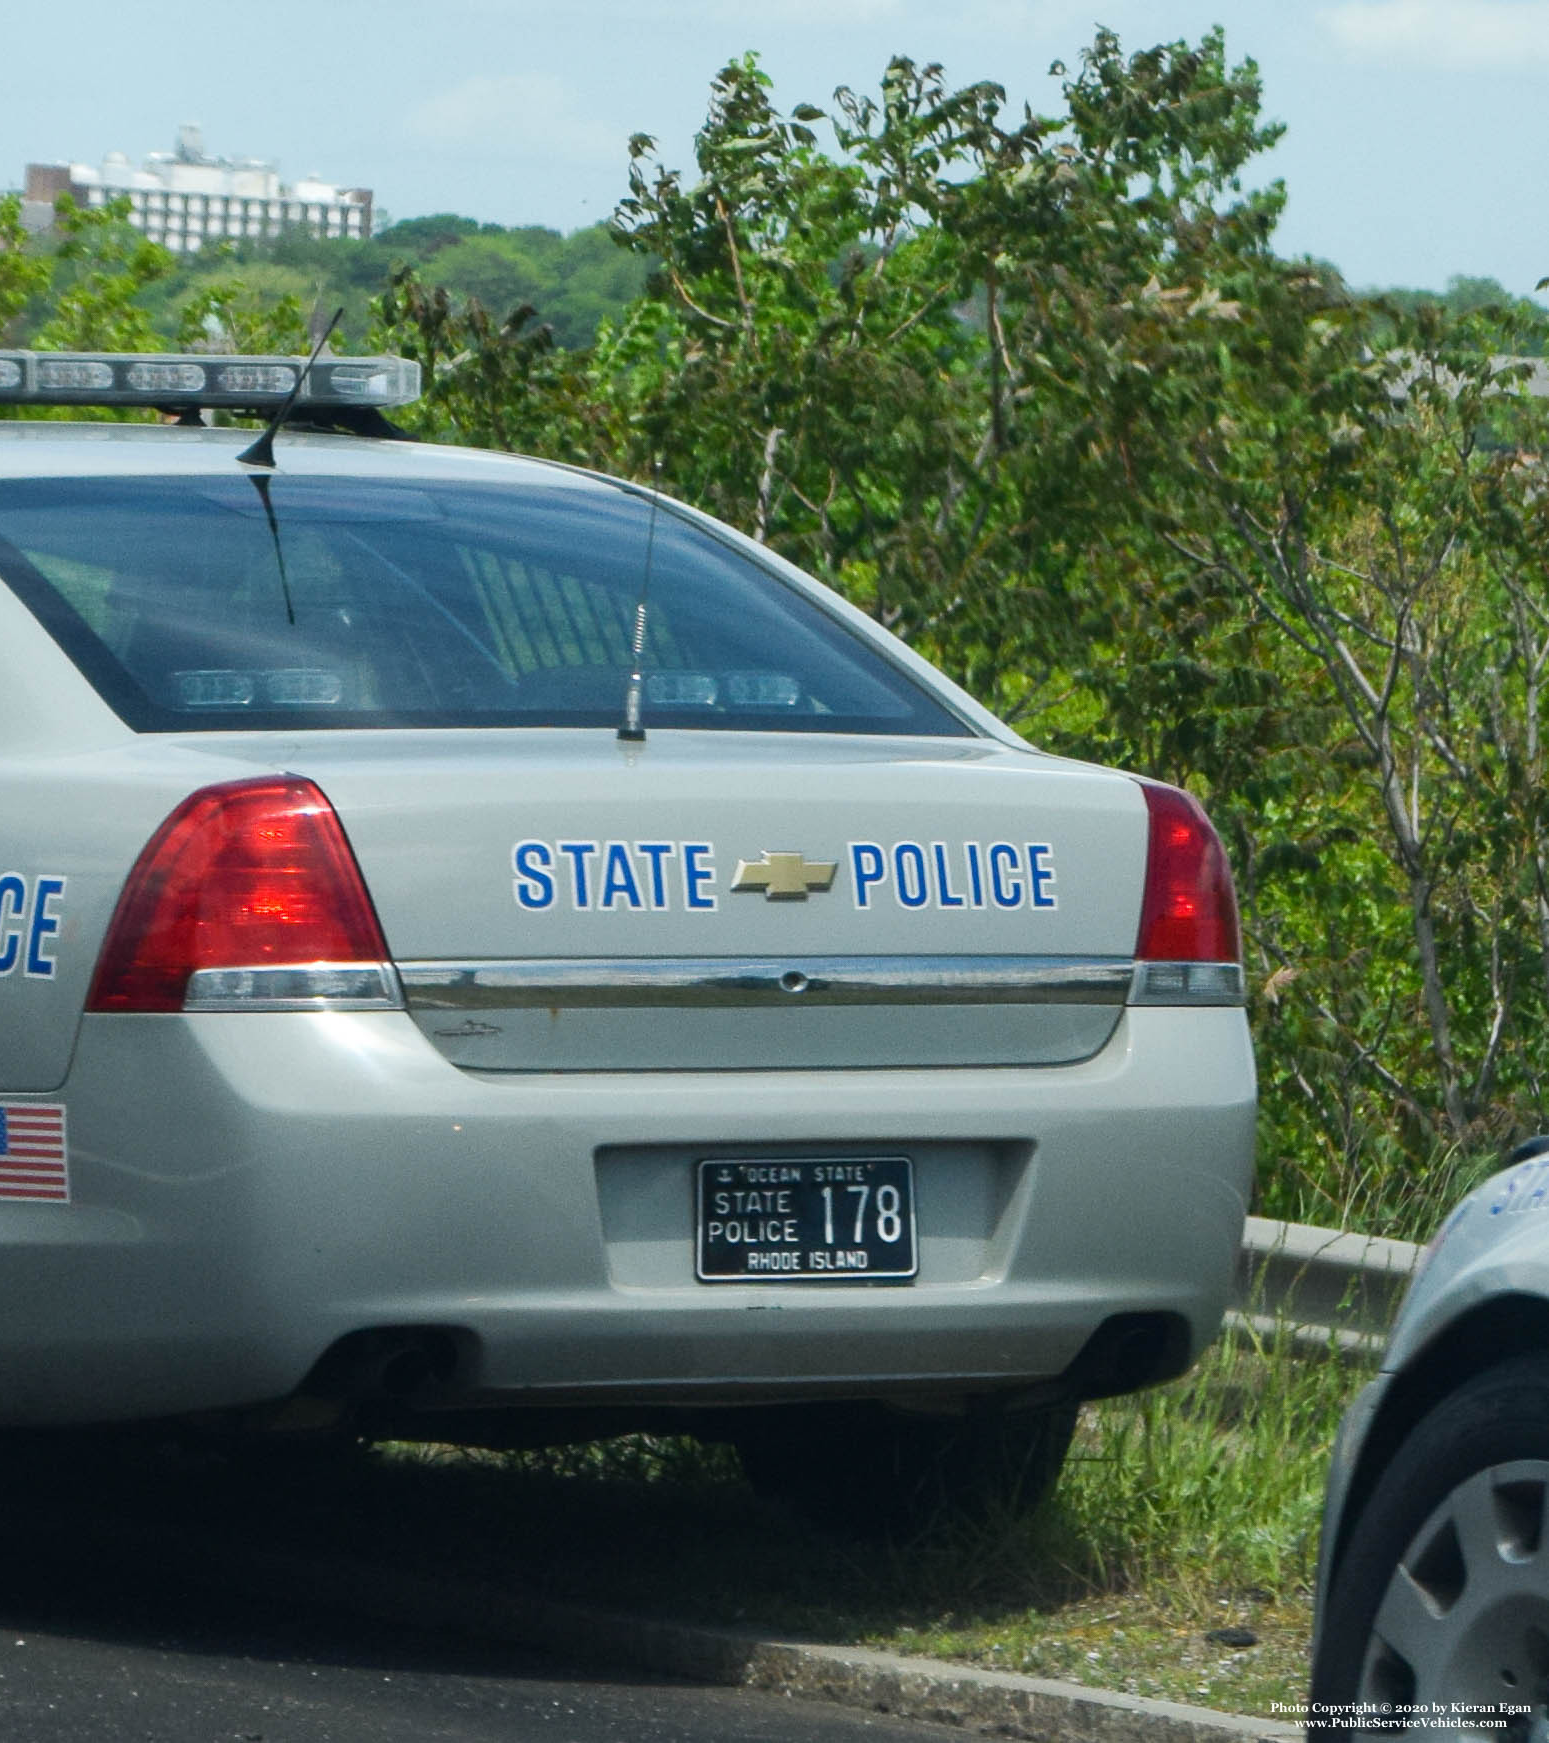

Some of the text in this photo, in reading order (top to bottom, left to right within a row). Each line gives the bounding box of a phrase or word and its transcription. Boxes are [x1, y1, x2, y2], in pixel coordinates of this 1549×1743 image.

[512, 840, 1057, 911] STATE POLICE
[715, 1191, 791, 1214] STATE
[821, 1185, 901, 1244] 178
[708, 1220, 799, 1243] POLICE
[748, 1251, 867, 1270] RHODE ISLAND
